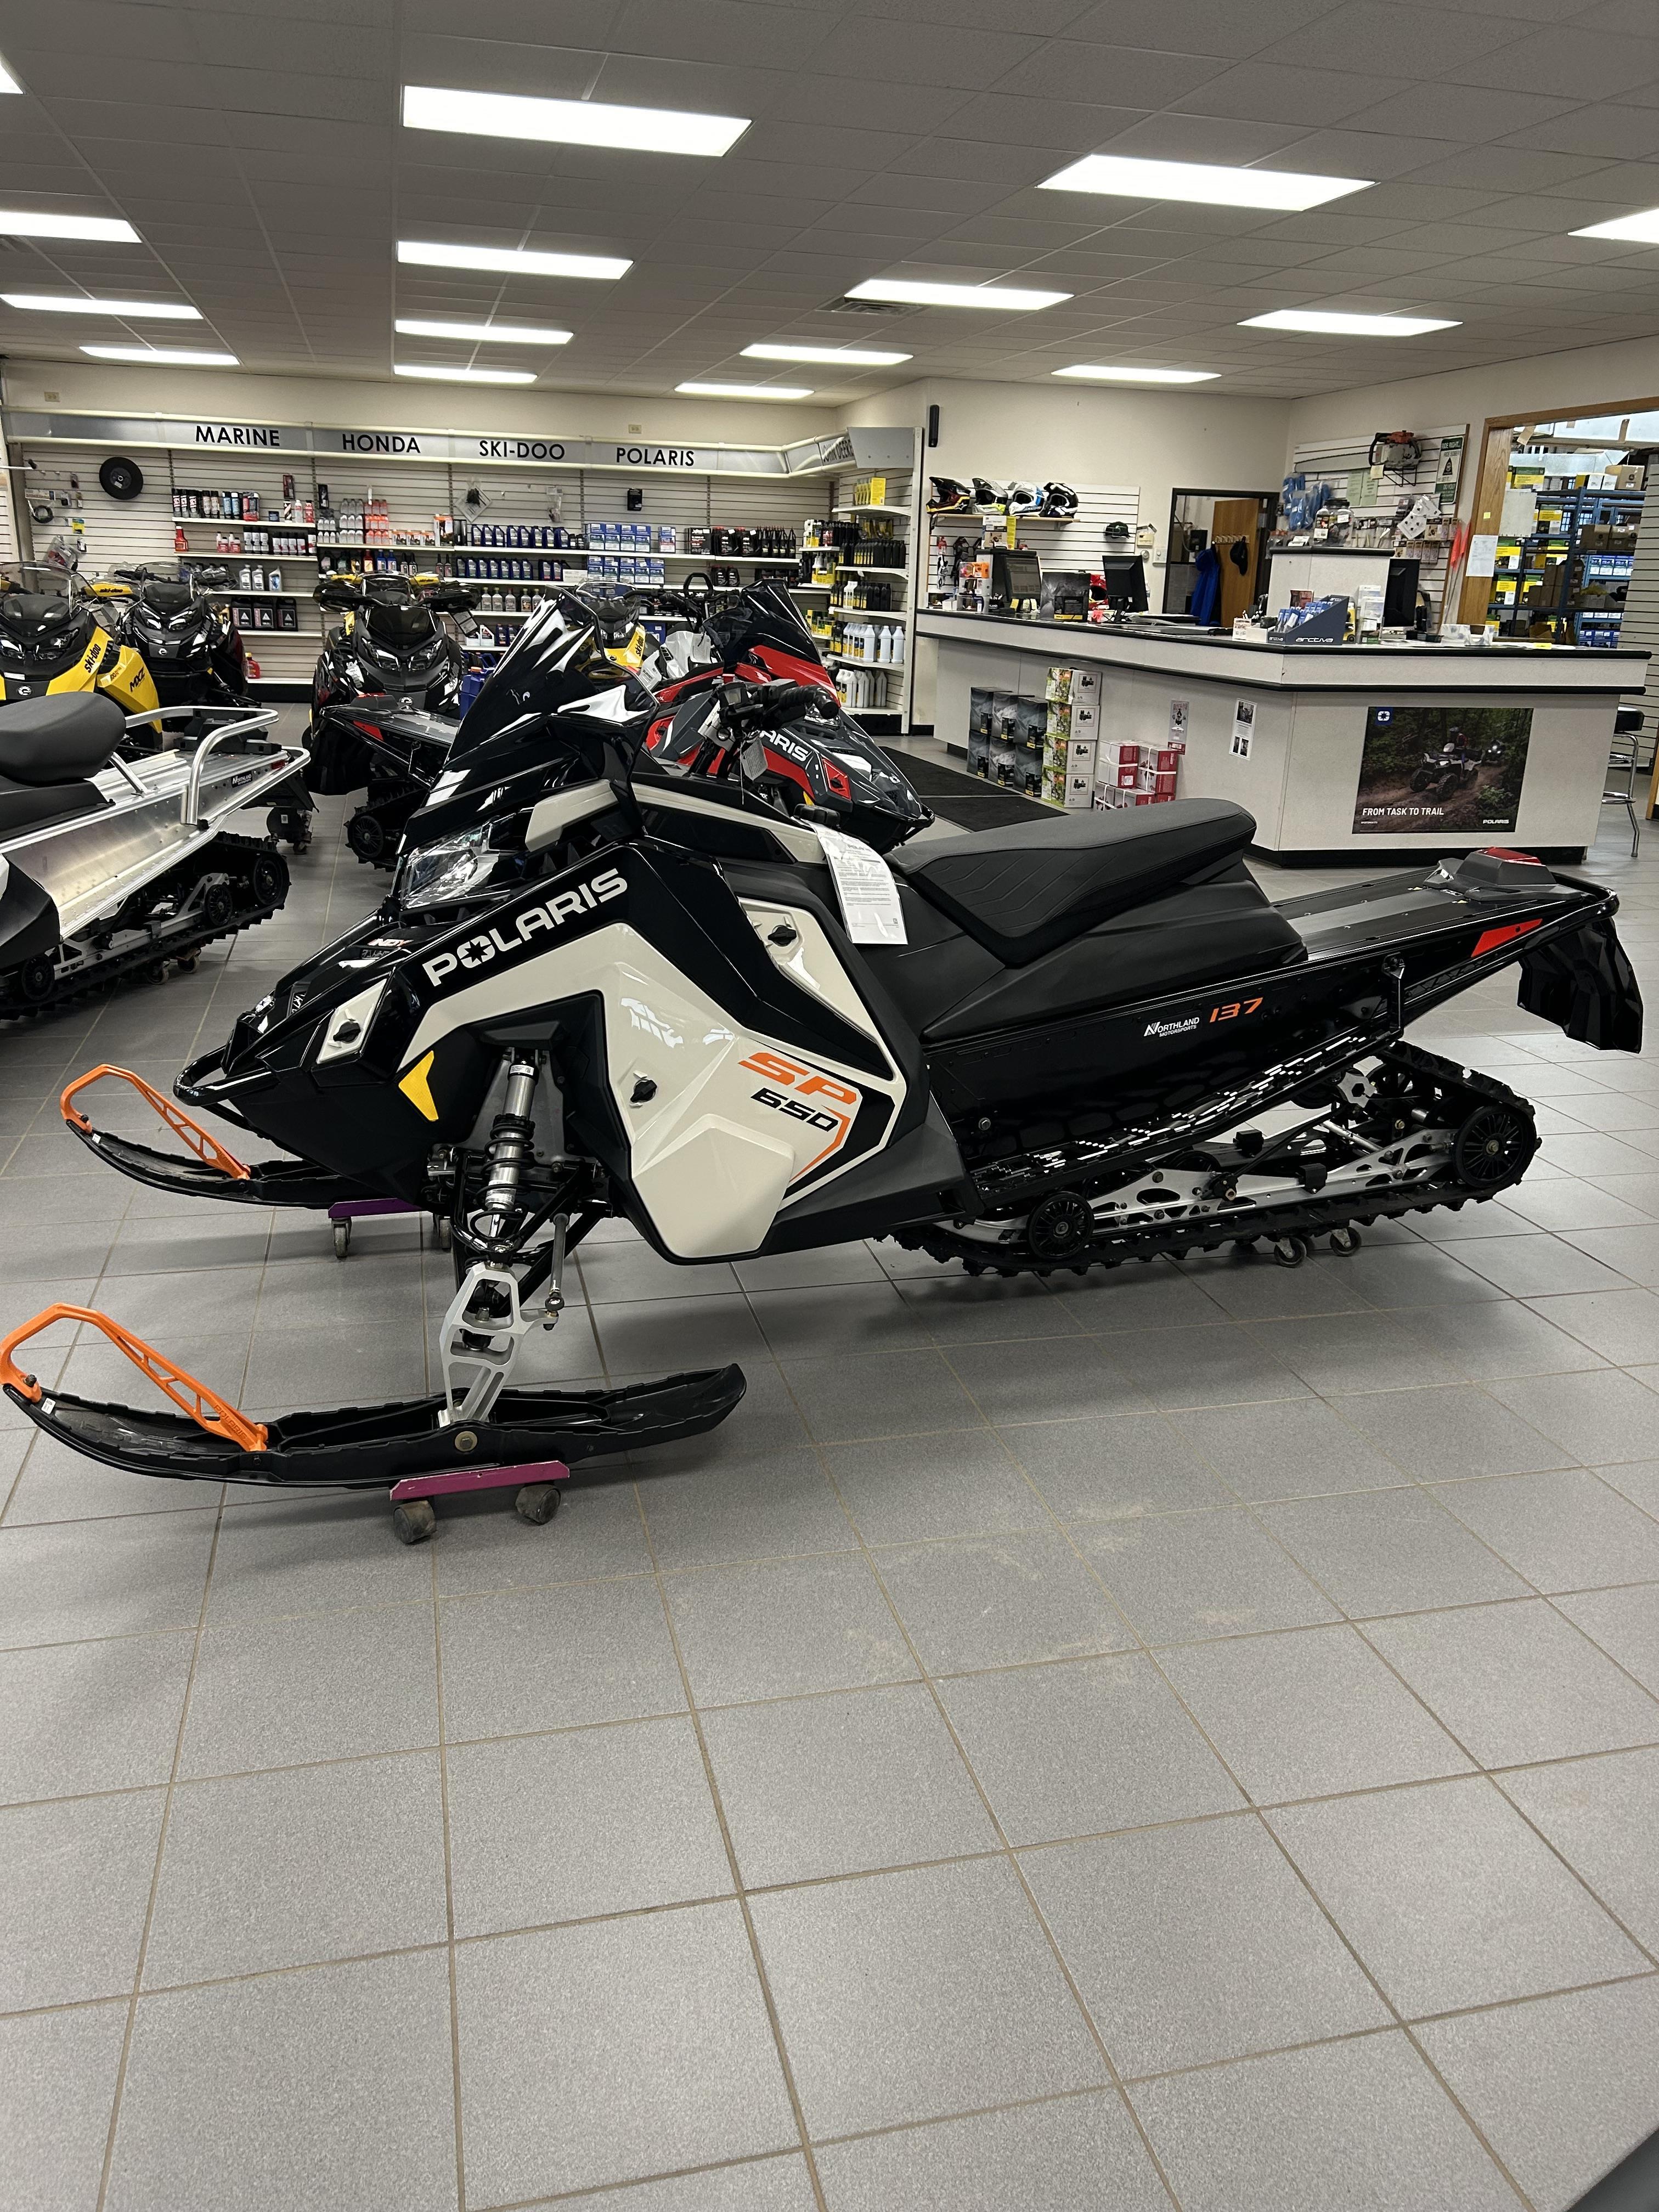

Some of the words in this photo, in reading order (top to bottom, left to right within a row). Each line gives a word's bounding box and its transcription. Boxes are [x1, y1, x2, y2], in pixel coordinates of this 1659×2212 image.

[195, 425, 280, 447] MARINE
[342, 433, 421, 453] HONDA
[479, 440, 566, 461] SKI-DOO
[616, 447, 695, 466] POLARIS
[635, 635, 644, 657] ski-doo
[84, 643, 101, 674] ski-doo
[129, 666, 145, 692] MXZ
[761, 730, 809, 762] ARIS
[1362, 808, 1385, 816] FROM
[1386, 808, 1407, 816] TASK
[1409, 808, 1420, 816] TO
[1421, 807, 1444, 816] TRAIL
[422, 868, 628, 986] POLARIS
[1210, 997, 1263, 1023] 137
[1143, 1017, 1200, 1037] NORTHLAND
[1159, 1024, 1197, 1037] MOTORSPORTS
[737, 1052, 857, 1105] SP
[750, 1087, 839, 1132] 650
[213, 1404, 247, 1441] POLARIS
